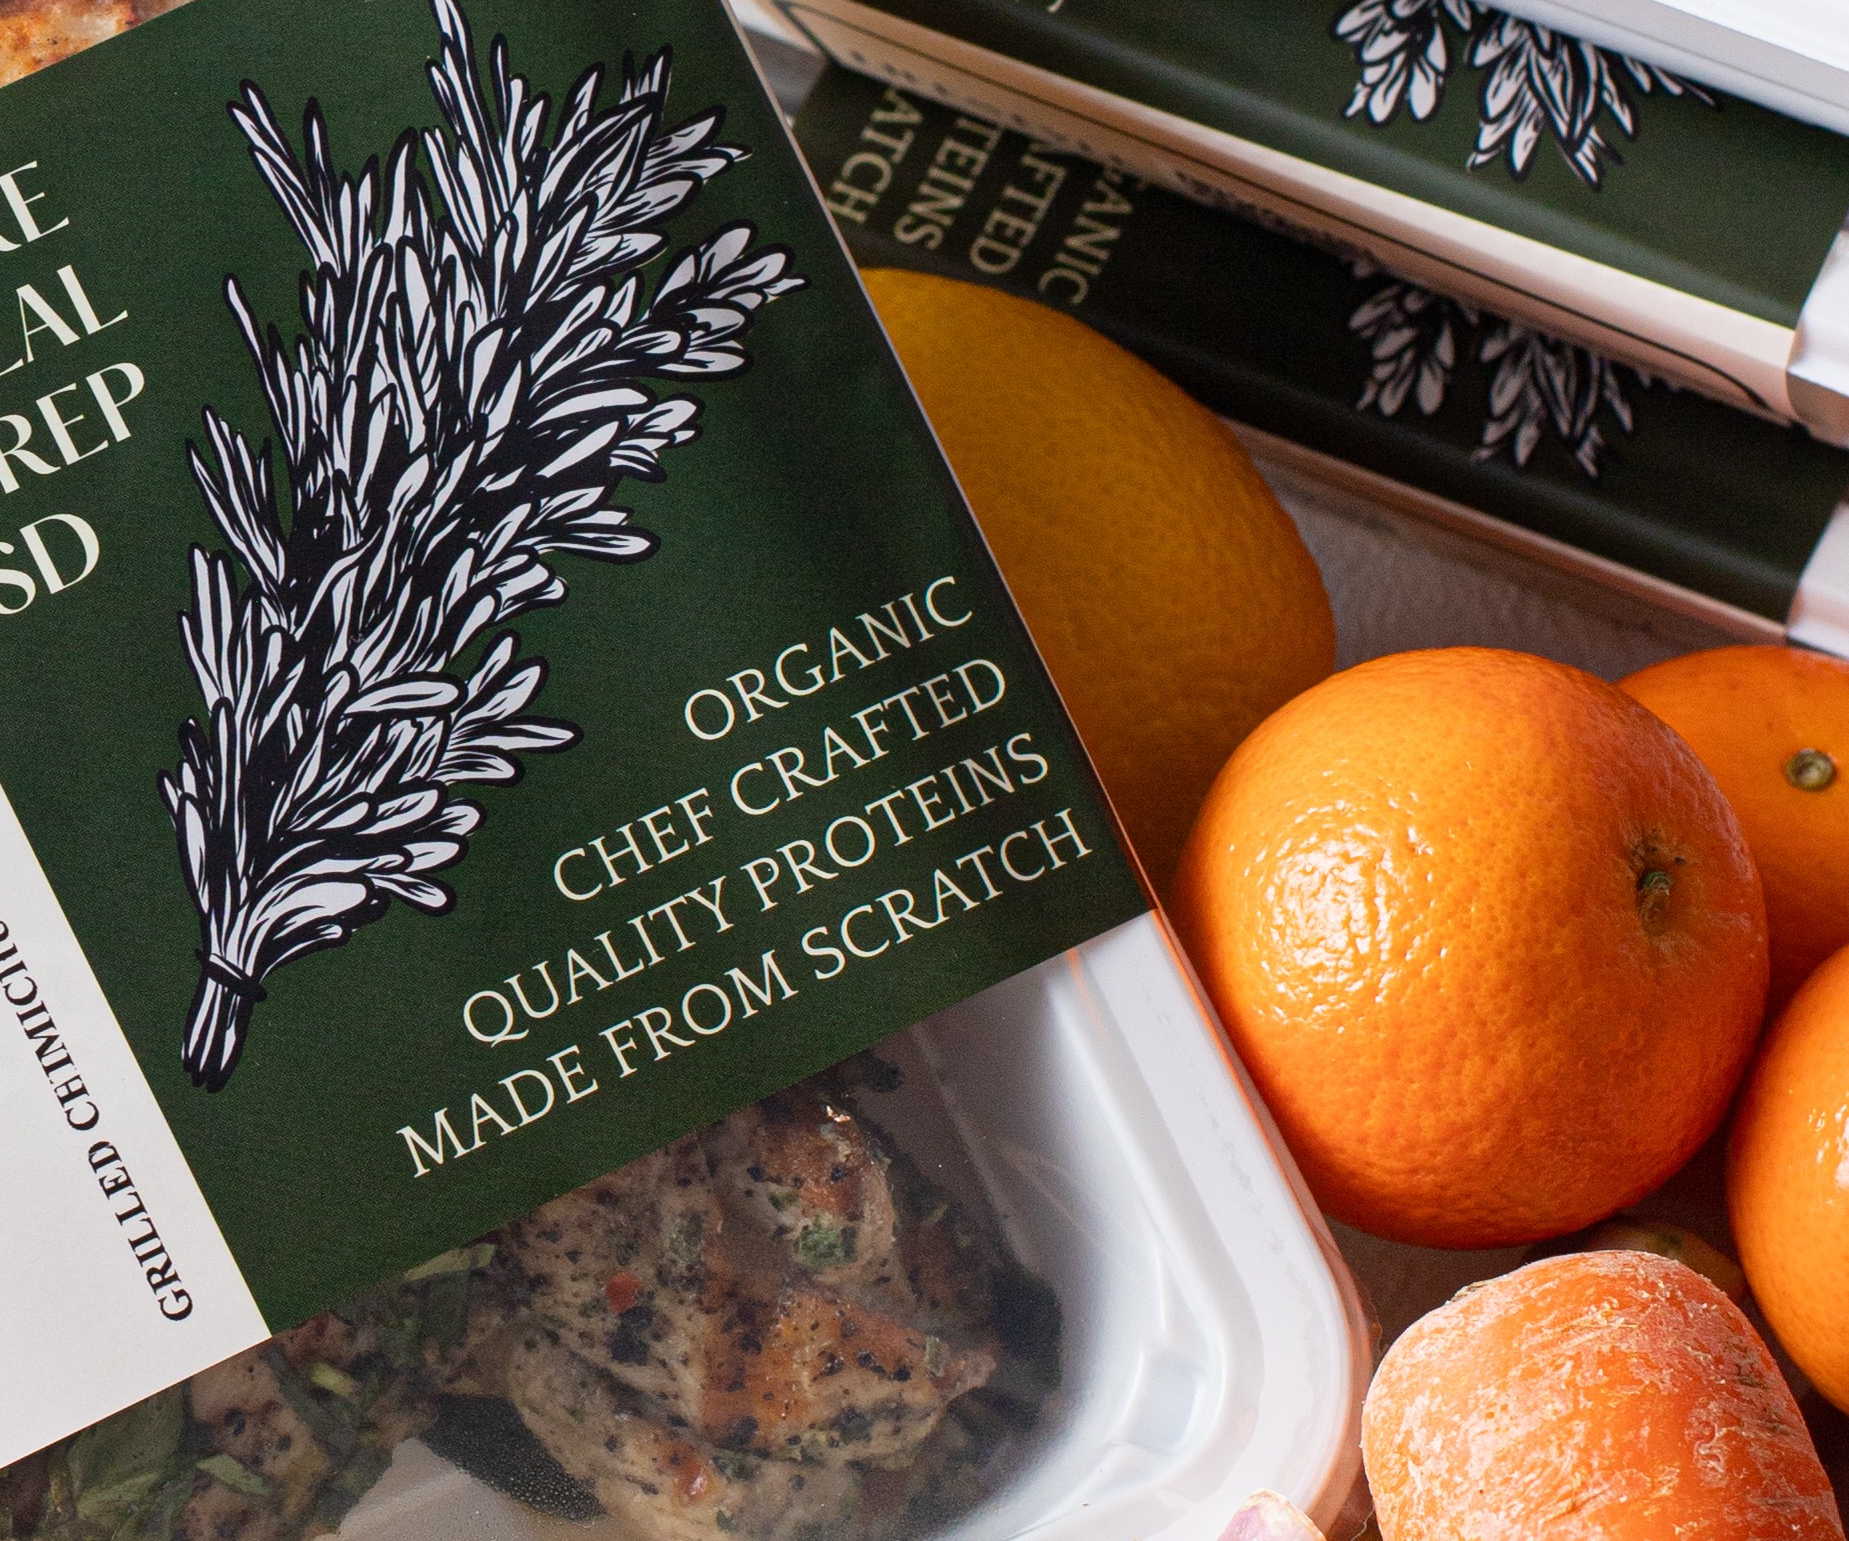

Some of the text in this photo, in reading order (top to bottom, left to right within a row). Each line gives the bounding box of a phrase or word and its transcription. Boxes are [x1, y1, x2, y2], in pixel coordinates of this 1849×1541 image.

[554, 658, 1007, 902] CHEF CRAFTED
[684, 575, 973, 742] ORGANIC
[395, 807, 1095, 1179] MADE FROM SCRATCH
[463, 732, 1050, 1048] QUALITY PROTEINS
[87, 1140, 194, 1322] GRILLED
